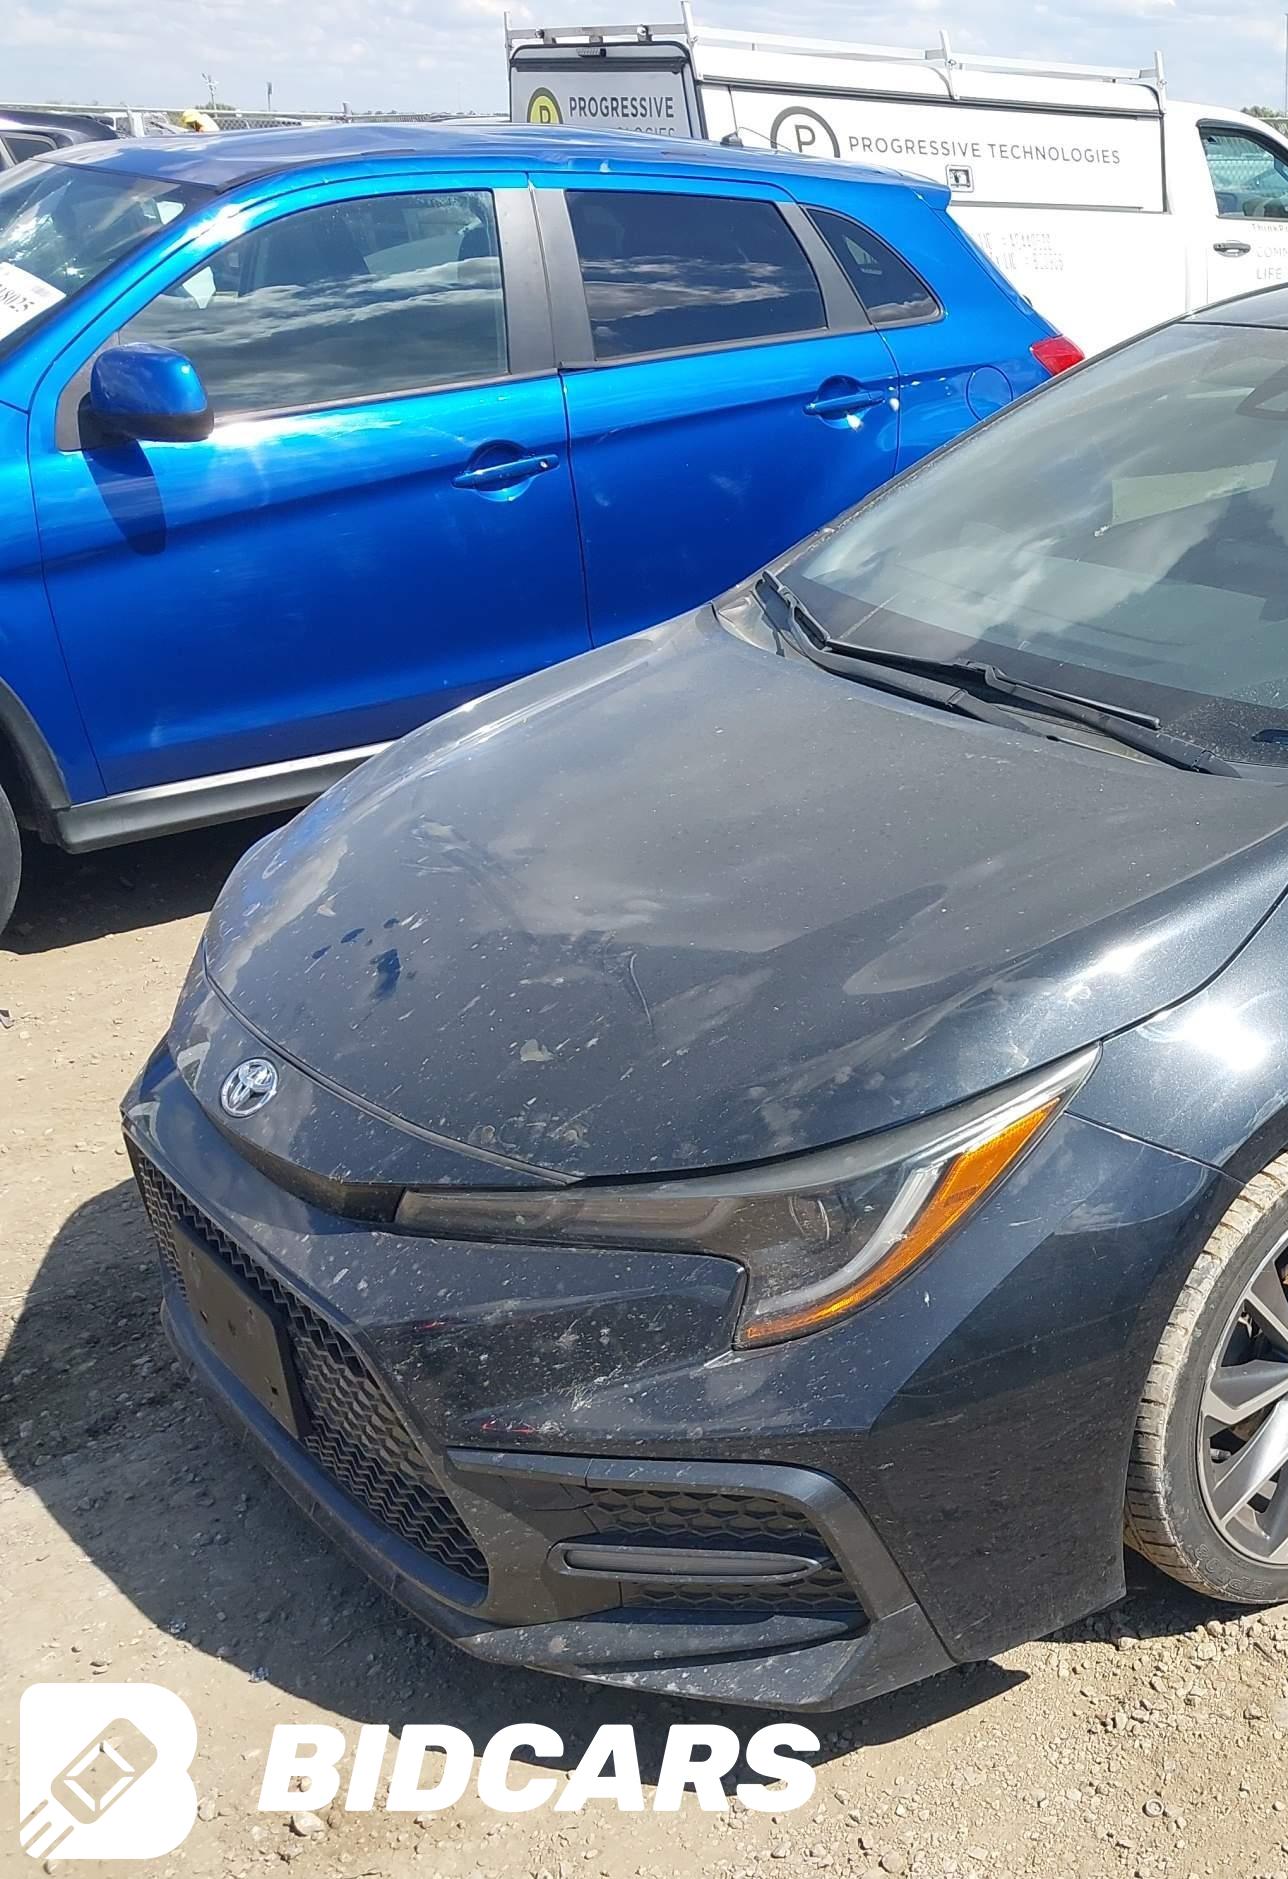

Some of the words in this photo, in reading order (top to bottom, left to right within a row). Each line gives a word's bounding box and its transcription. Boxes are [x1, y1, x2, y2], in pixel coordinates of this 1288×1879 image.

[569, 96, 675, 118] PROGRESSIVE
[848, 135, 982, 159] PROGRESSIVE
[987, 143, 1121, 165] TECHNOLOGIES
[1256, 267, 1282, 280] LIFE
